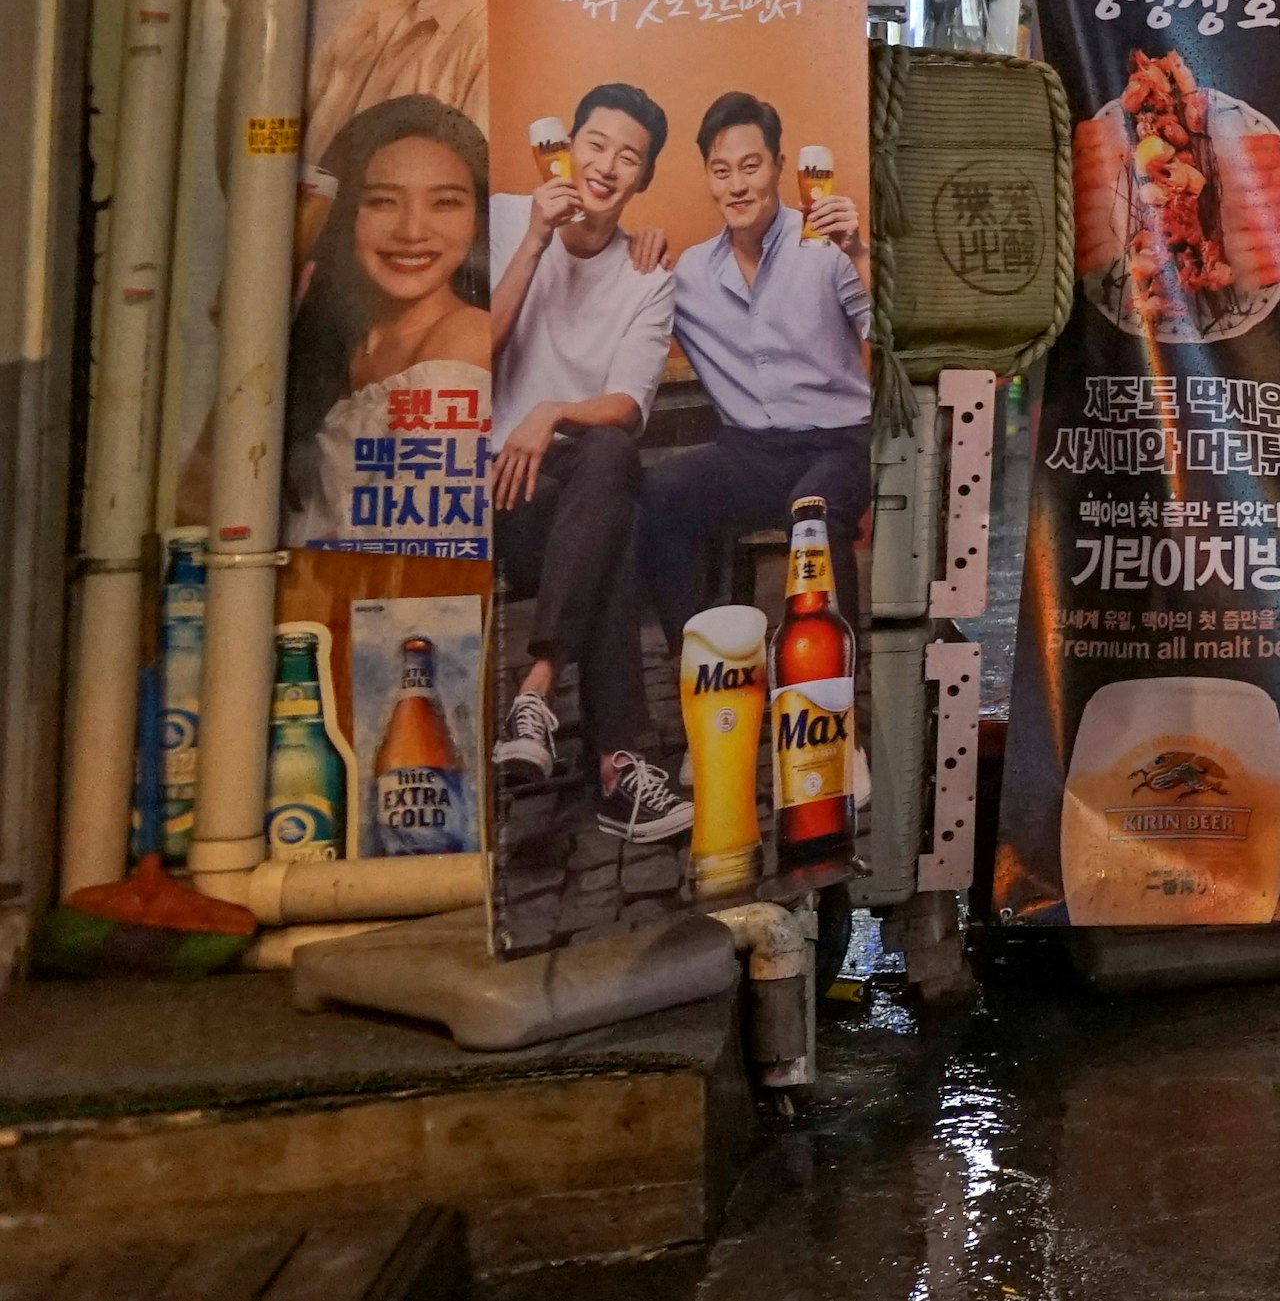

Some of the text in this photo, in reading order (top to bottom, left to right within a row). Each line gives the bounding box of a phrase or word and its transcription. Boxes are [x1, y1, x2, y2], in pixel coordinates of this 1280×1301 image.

[387, 389, 493, 433] 됐고,
[1083, 376, 1180, 422] 제주도
[355, 437, 491, 480] 맥주나
[1044, 428, 1182, 476] 사시미와
[351, 485, 490, 528] 마시자
[1079, 500, 1136, 528] 맥아의
[1138, 500, 1159, 528] 첫
[1160, 501, 1210, 528] 즙만
[802, 559, 818, 581] 生
[1141, 610, 1192, 632] 맥아의
[1199, 609, 1218, 631] 첫
[1047, 633, 1151, 661] Premium
[1156, 635, 1187, 660] all
[1193, 634, 1252, 660] malt
[694, 661, 757, 696] Max
[777, 707, 849, 752] Max
[384, 787, 451, 808] EXTRA
[388, 808, 447, 829] COLD
[1122, 813, 1235, 831] KIRIN BEER
